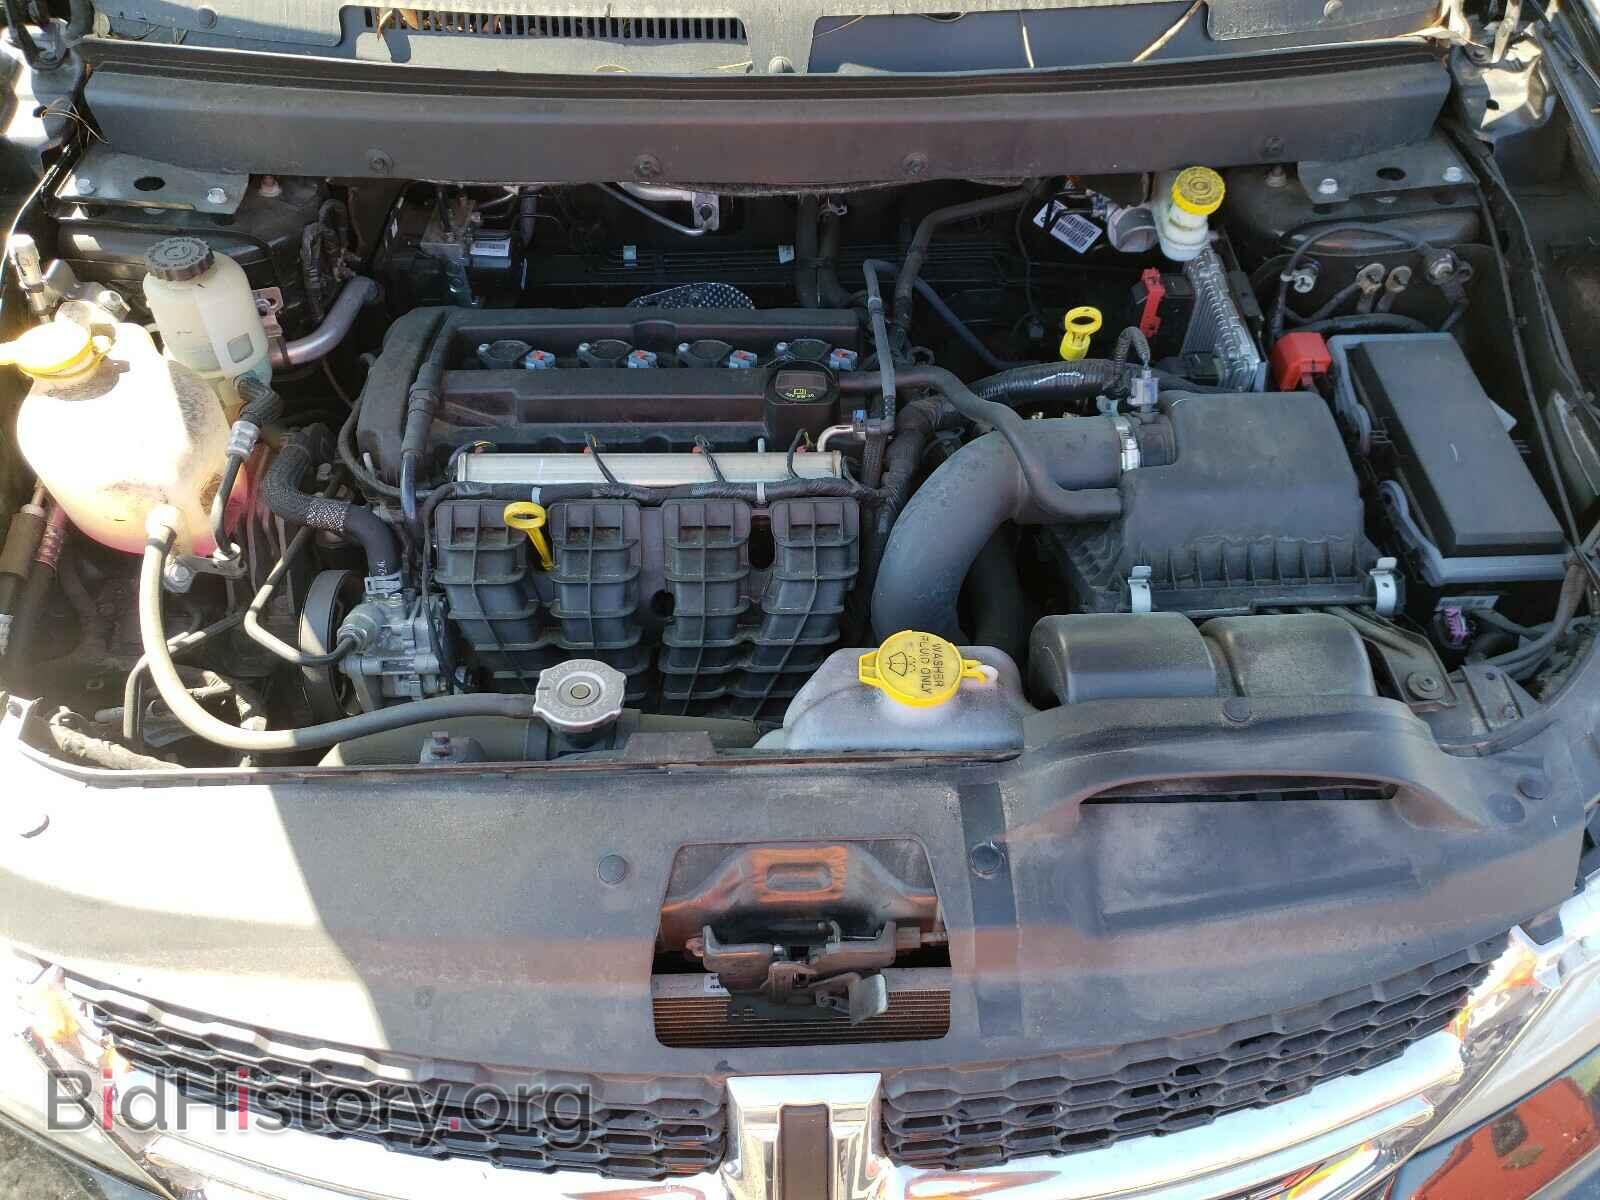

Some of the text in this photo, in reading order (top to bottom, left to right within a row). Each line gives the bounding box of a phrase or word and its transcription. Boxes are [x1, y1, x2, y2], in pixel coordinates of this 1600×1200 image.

[920, 635, 932, 694] FLUID ONLY
[933, 643, 944, 688] WASHER
